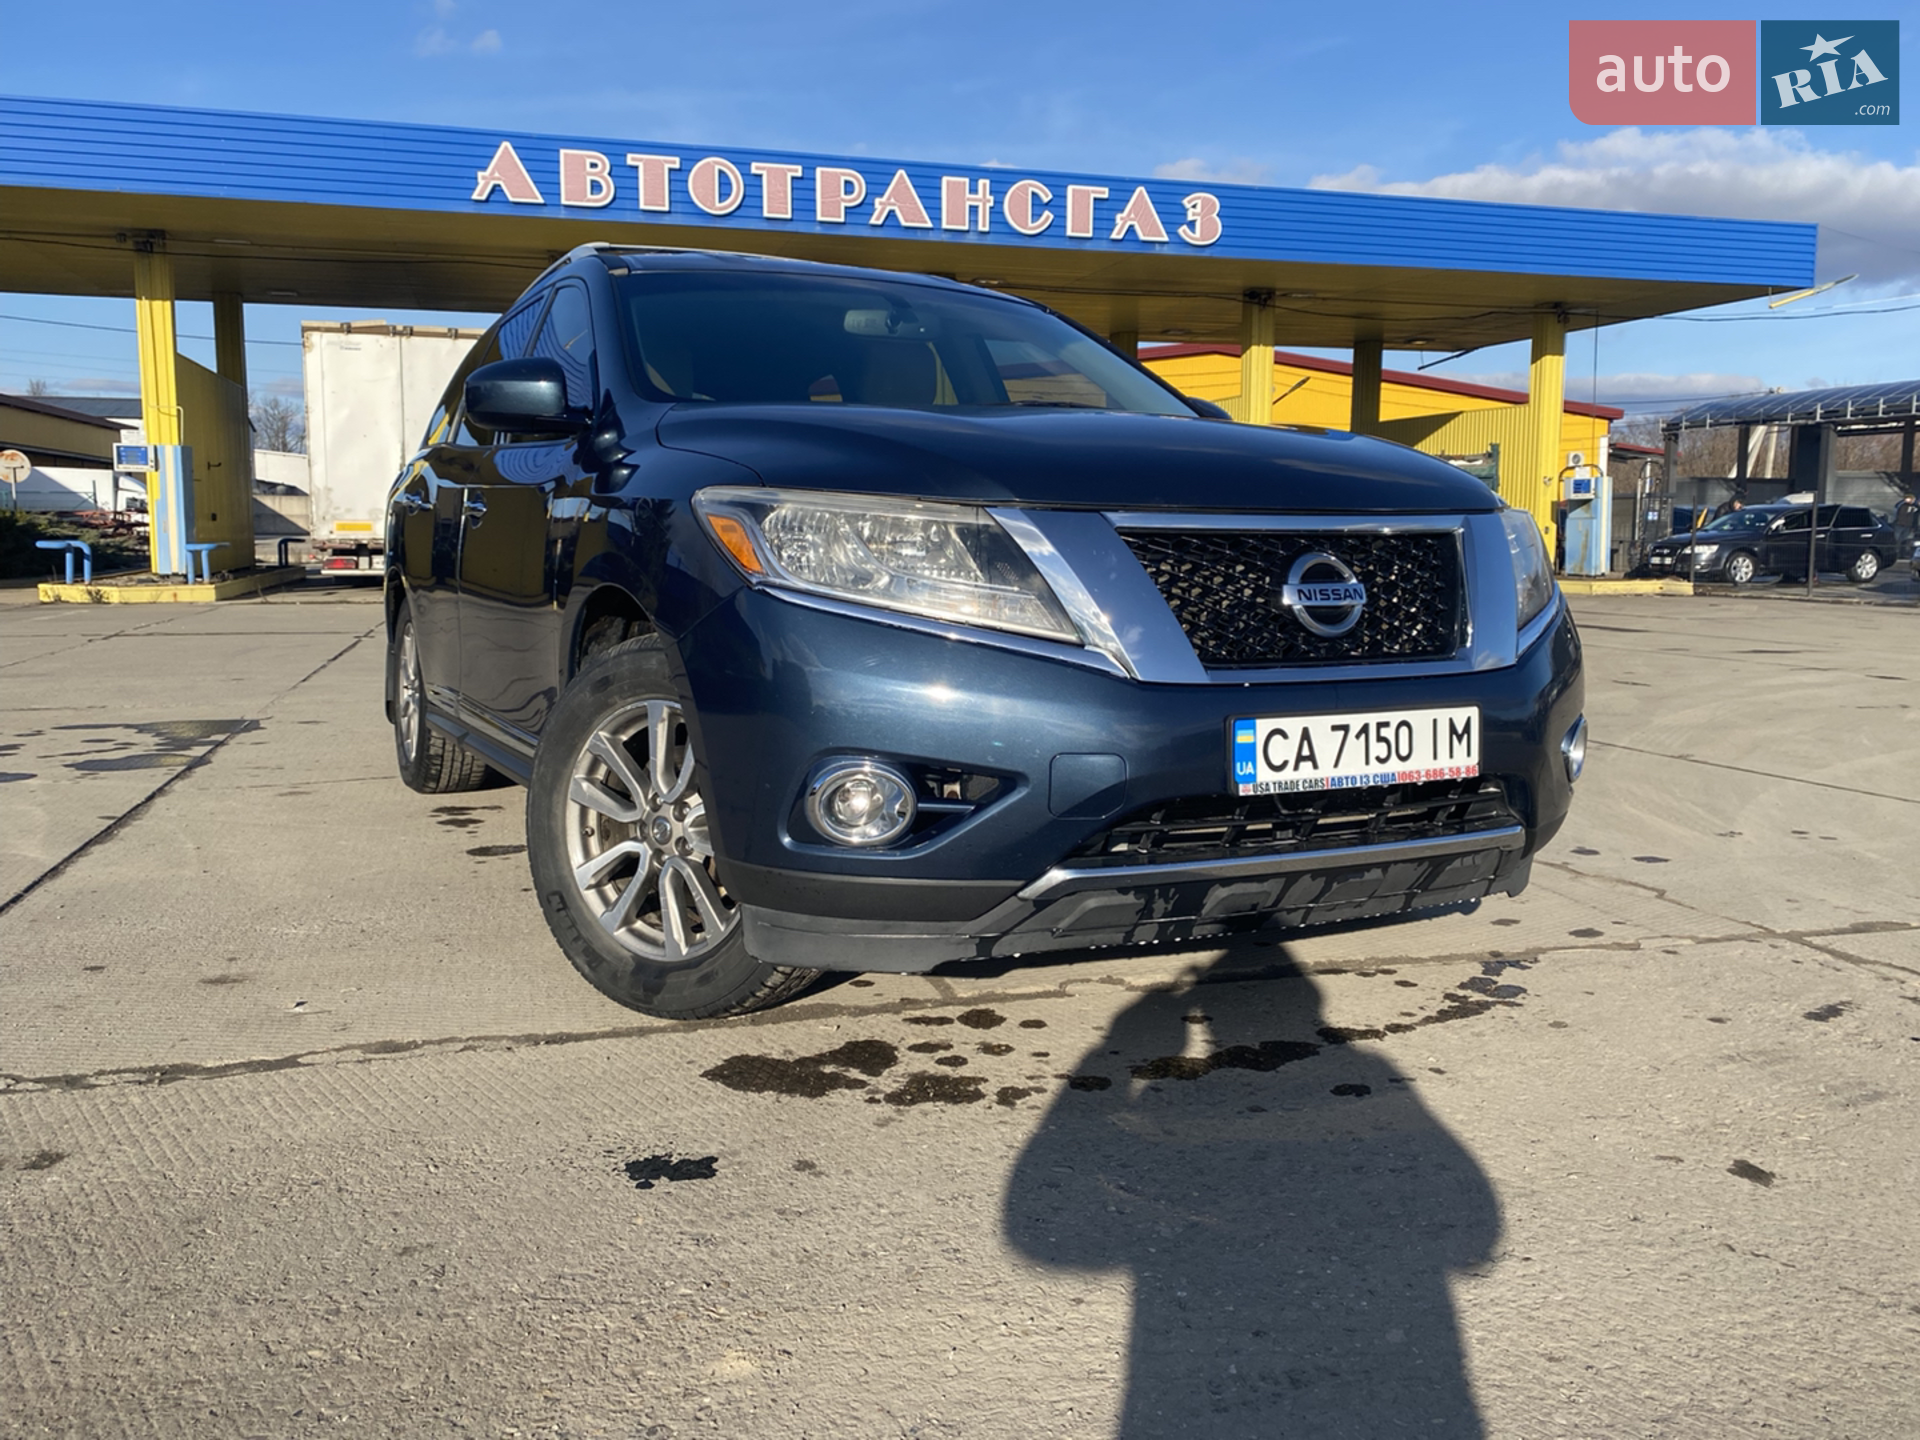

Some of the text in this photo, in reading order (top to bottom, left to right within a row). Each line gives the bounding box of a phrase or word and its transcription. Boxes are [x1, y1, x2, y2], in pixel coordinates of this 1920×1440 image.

[471, 140, 1224, 247] АВТОТРАНСГАЗ
[1296, 588, 1364, 602] NISSAN
[1262, 716, 1472, 773] CA 7150 IM
[1236, 761, 1255, 776] UA
[1252, 776, 1326, 794] USA TRADE CARS
